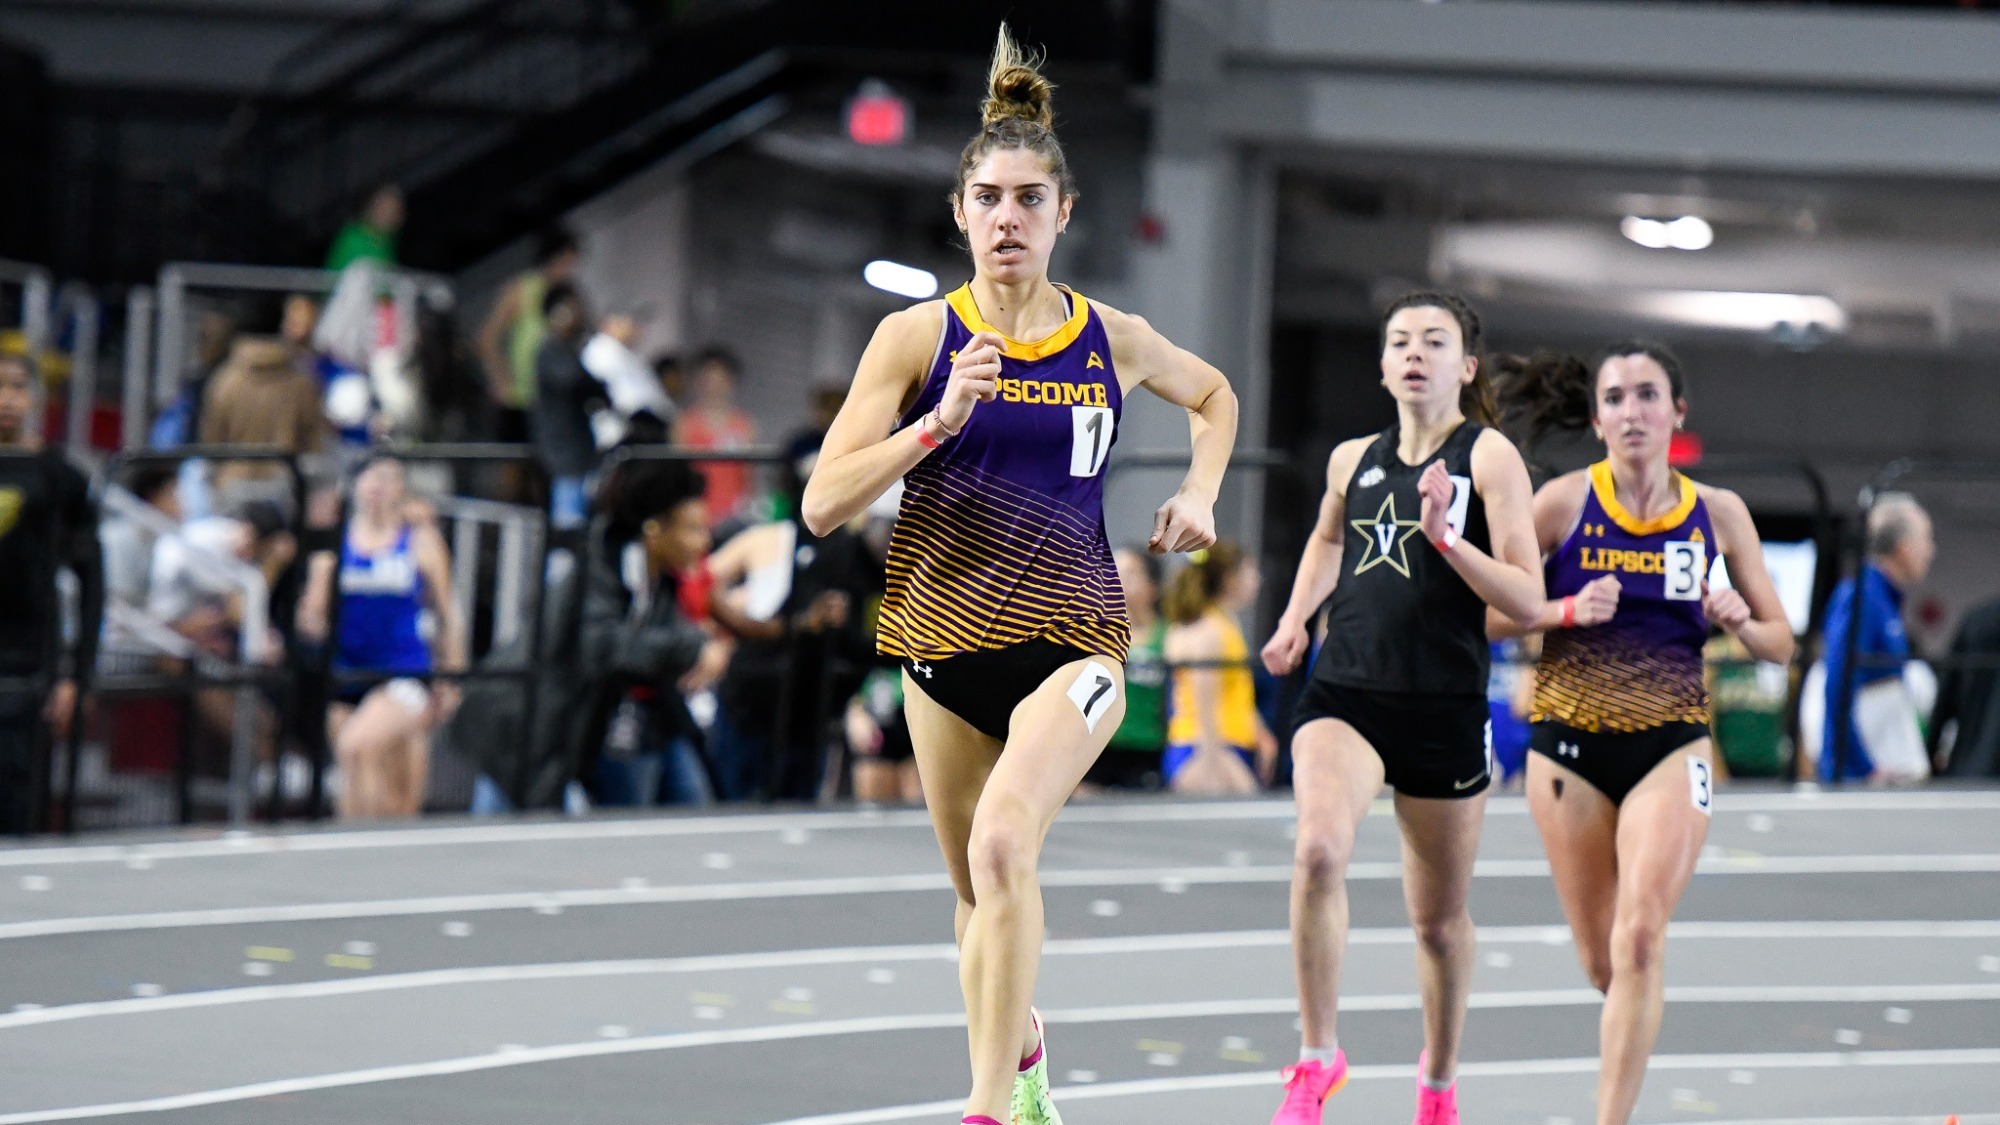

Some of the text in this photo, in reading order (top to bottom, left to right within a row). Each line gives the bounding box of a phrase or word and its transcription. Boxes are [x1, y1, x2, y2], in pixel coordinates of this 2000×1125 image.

[977, 377, 1108, 408] SCOMB
[1085, 411, 1104, 474] 1
[1374, 523, 1398, 556] V
[1580, 547, 1708, 576] LIPSCO
[1675, 547, 1695, 594] 3
[1696, 763, 1710, 807] 3
